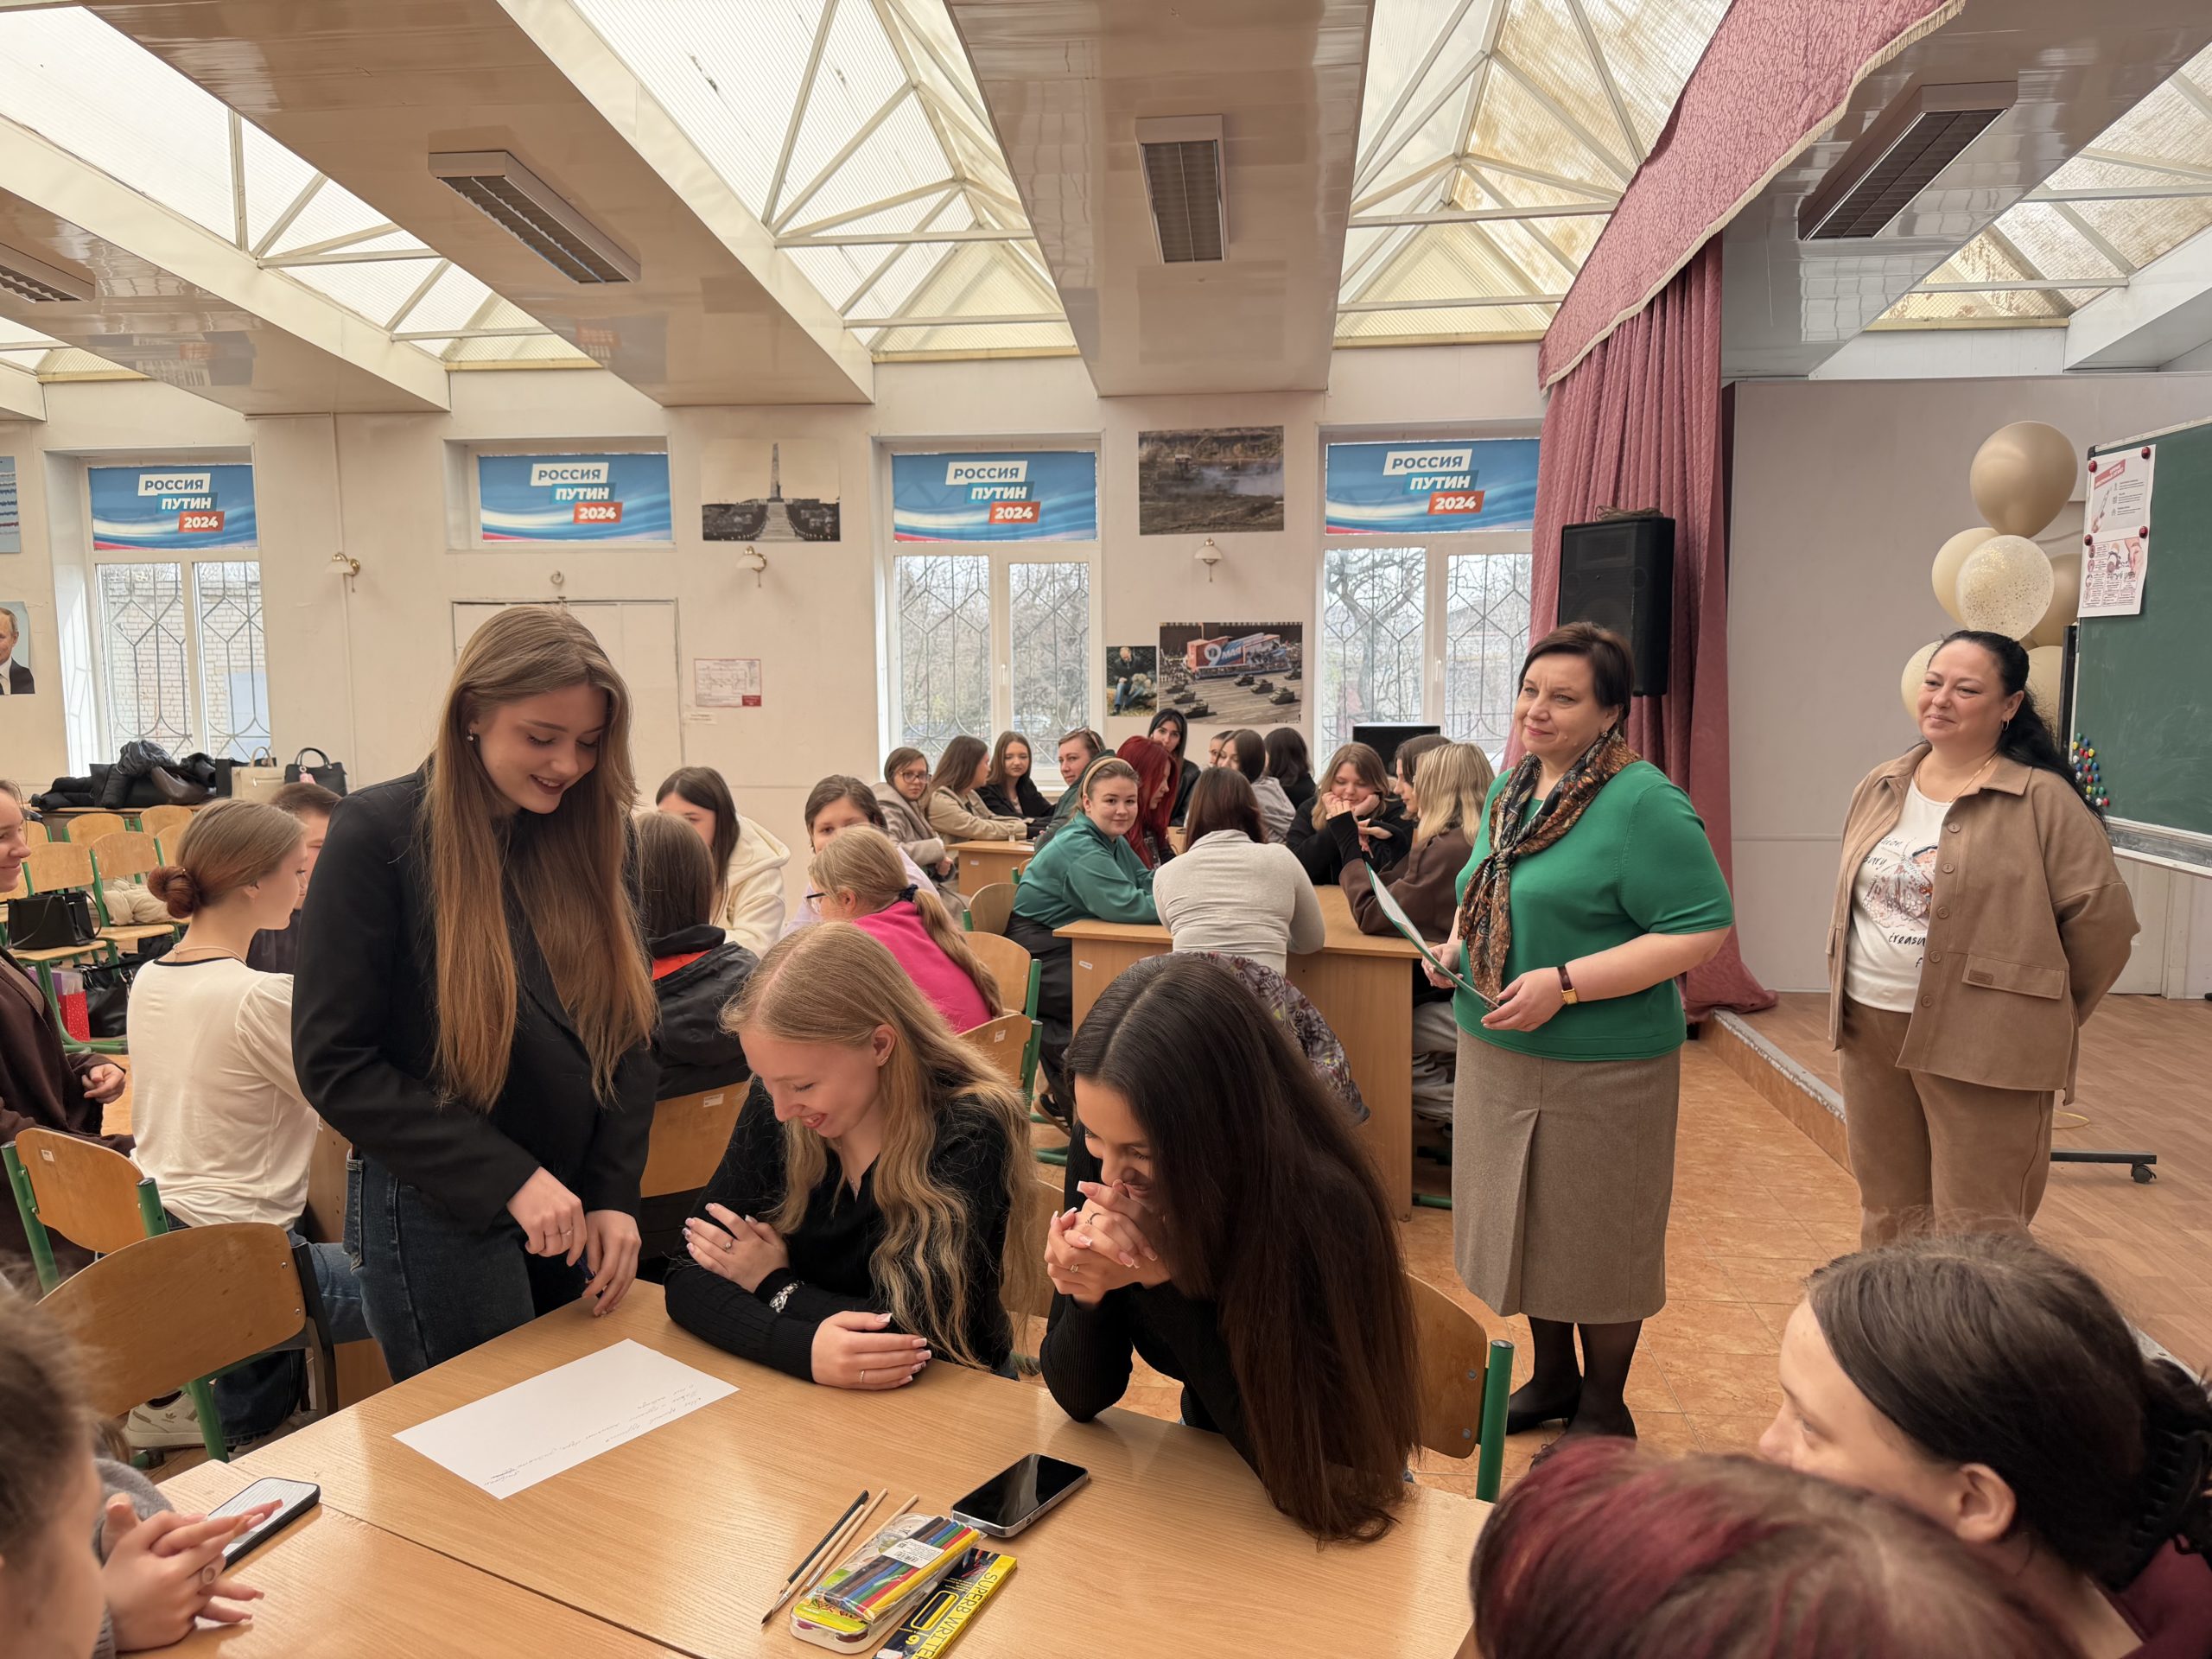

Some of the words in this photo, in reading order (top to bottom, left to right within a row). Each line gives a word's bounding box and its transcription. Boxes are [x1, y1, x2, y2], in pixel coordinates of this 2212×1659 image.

[1391, 455, 1464, 470] РОССИЯ
[537, 469, 601, 480] РОССИЯ
[953, 467, 1020, 480] РОССИЯ
[144, 480, 204, 491] РОССИЯ
[1409, 475, 1471, 490] ПУТИН
[555, 487, 609, 500] ПУТИН
[970, 486, 1027, 499] ПУТИН
[161, 498, 212, 510] ПУТИН
[1434, 496, 1477, 511] 2024
[579, 506, 617, 519] 2024
[995, 506, 1033, 519] 2024
[183, 517, 219, 529] 2024
[1205, 644, 1222, 666] 9
[956, 1572, 998, 1614] SUPERB
